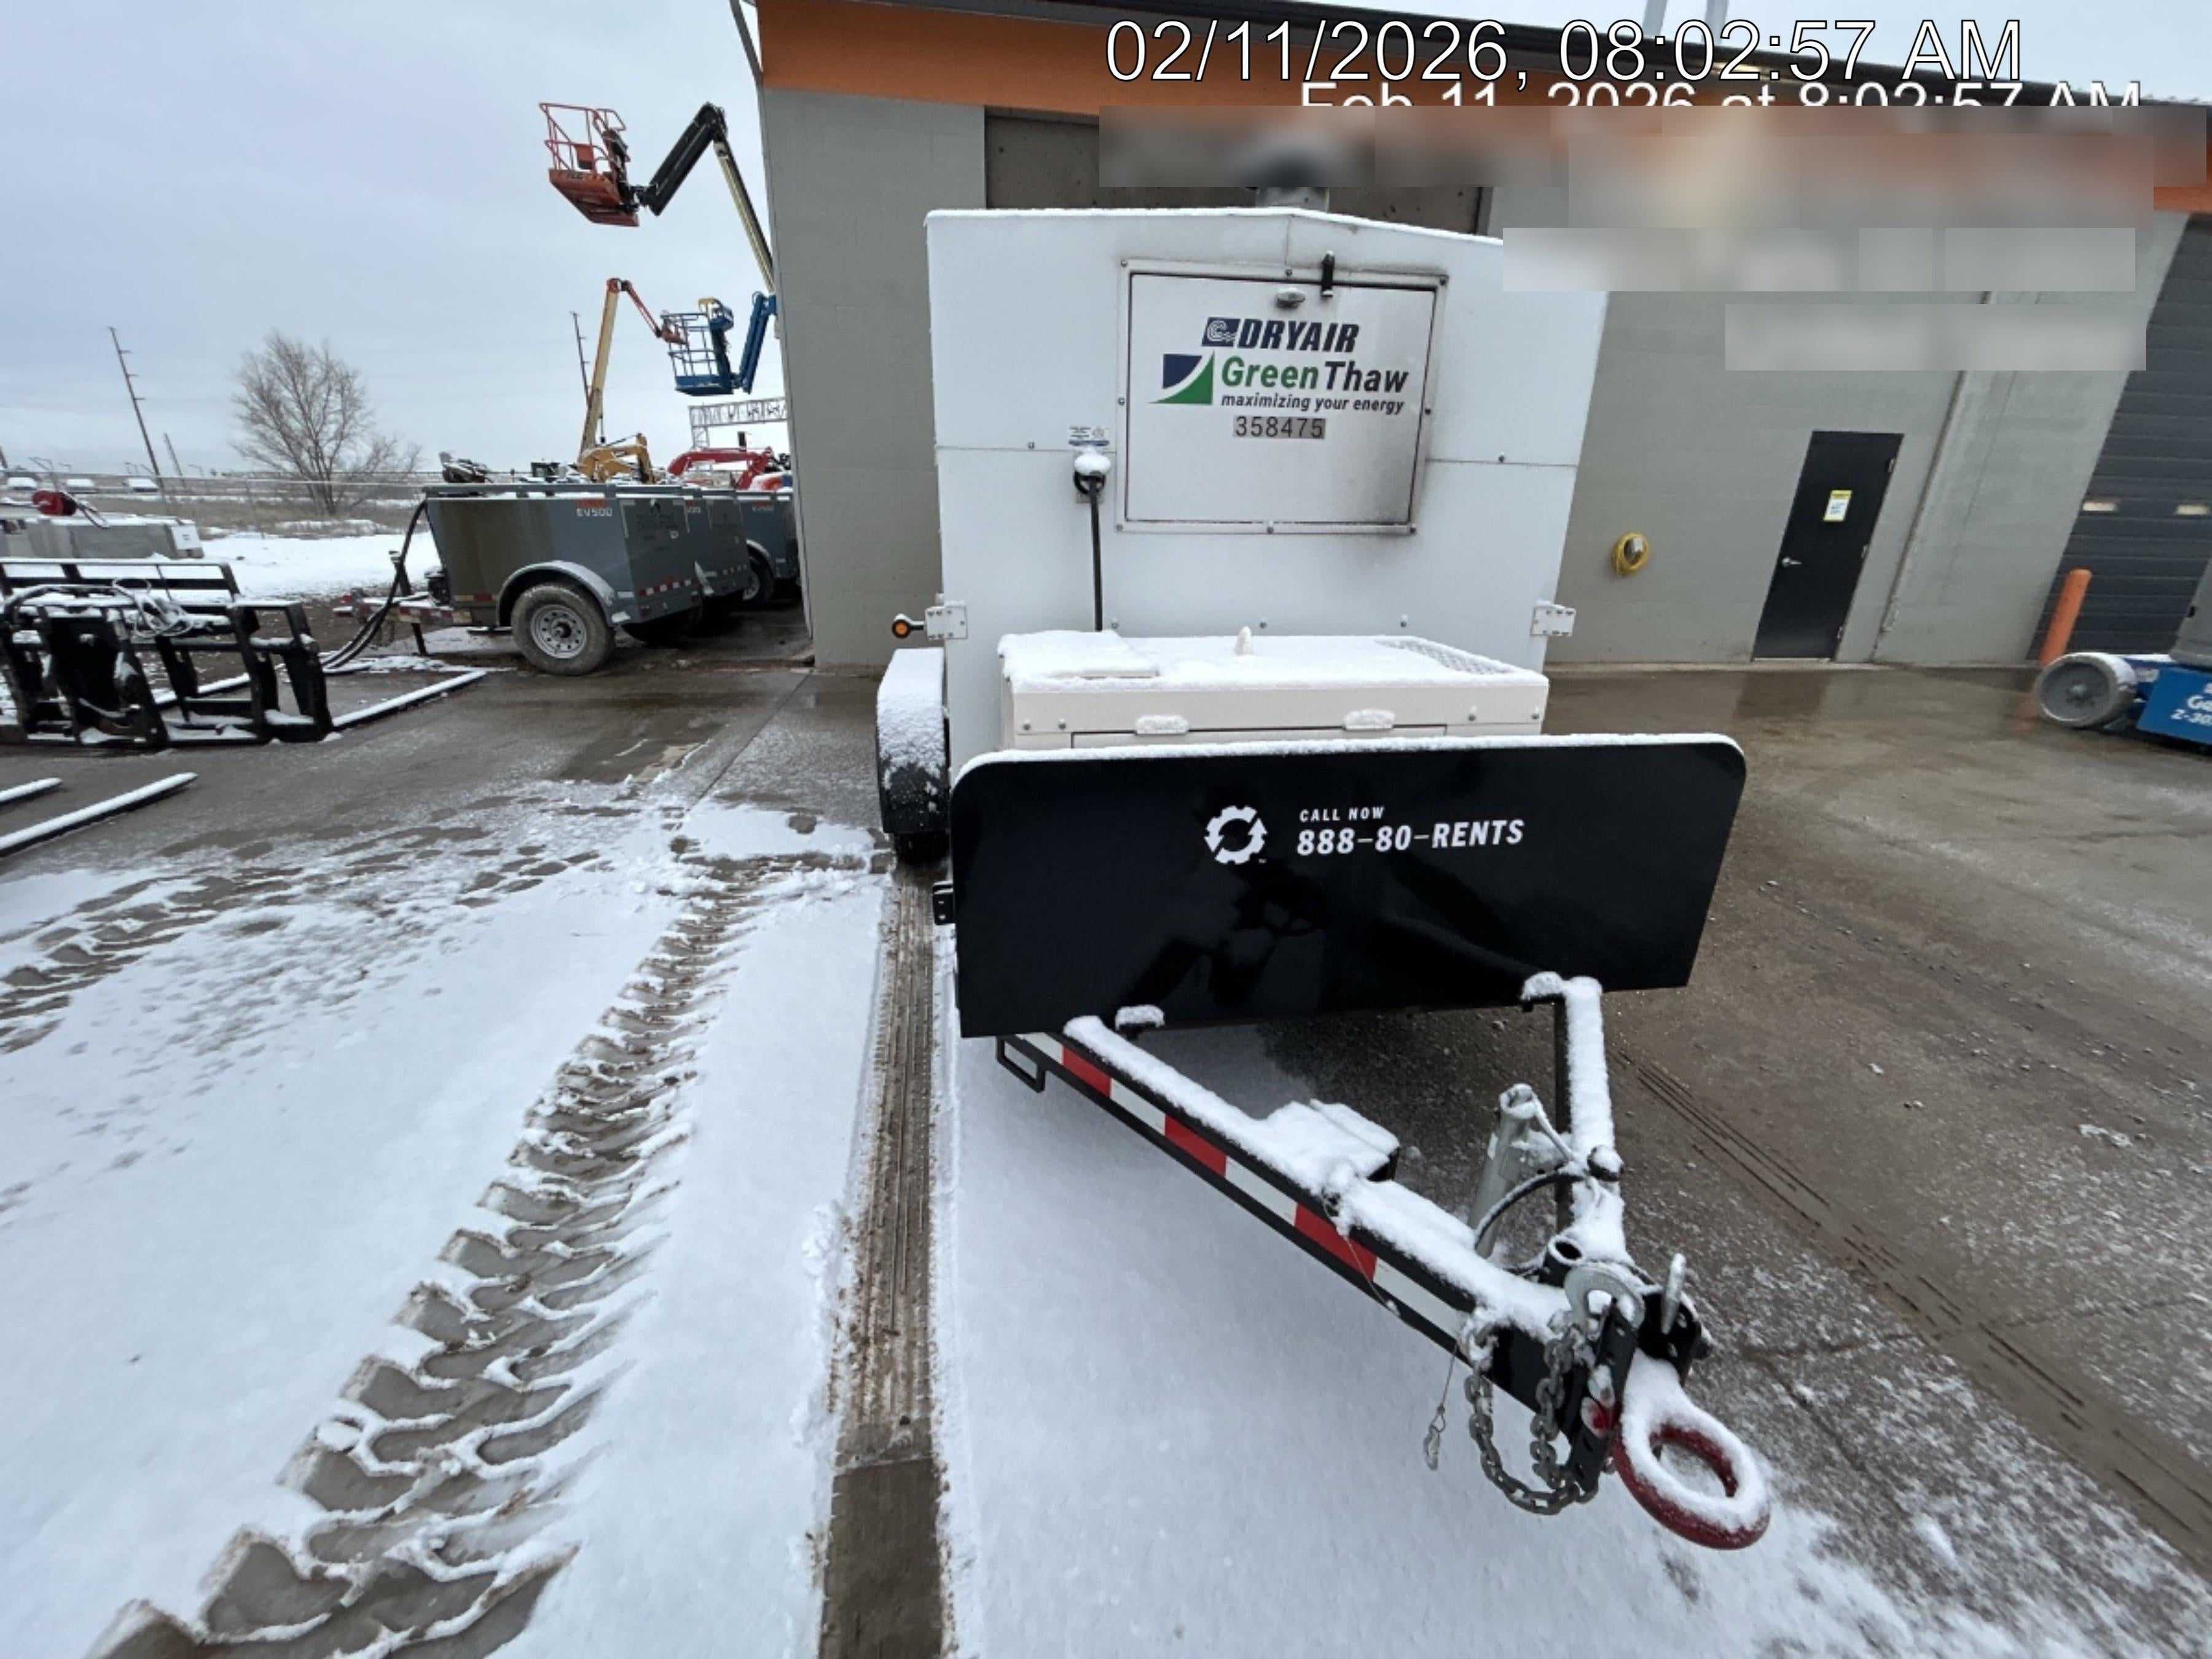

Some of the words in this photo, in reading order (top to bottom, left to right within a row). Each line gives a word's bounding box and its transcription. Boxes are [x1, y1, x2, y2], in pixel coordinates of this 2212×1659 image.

[1237, 319, 1359, 352] DRYAIR
[1222, 392, 1310, 412] maximizing
[1314, 398, 1349, 412] your
[1352, 399, 1405, 415] energy
[1235, 415, 1324, 439] 358475
[1299, 808, 1341, 823] CALL
[1349, 806, 1386, 820] NOW
[1296, 819, 1525, 855] 888-80-RENTS
